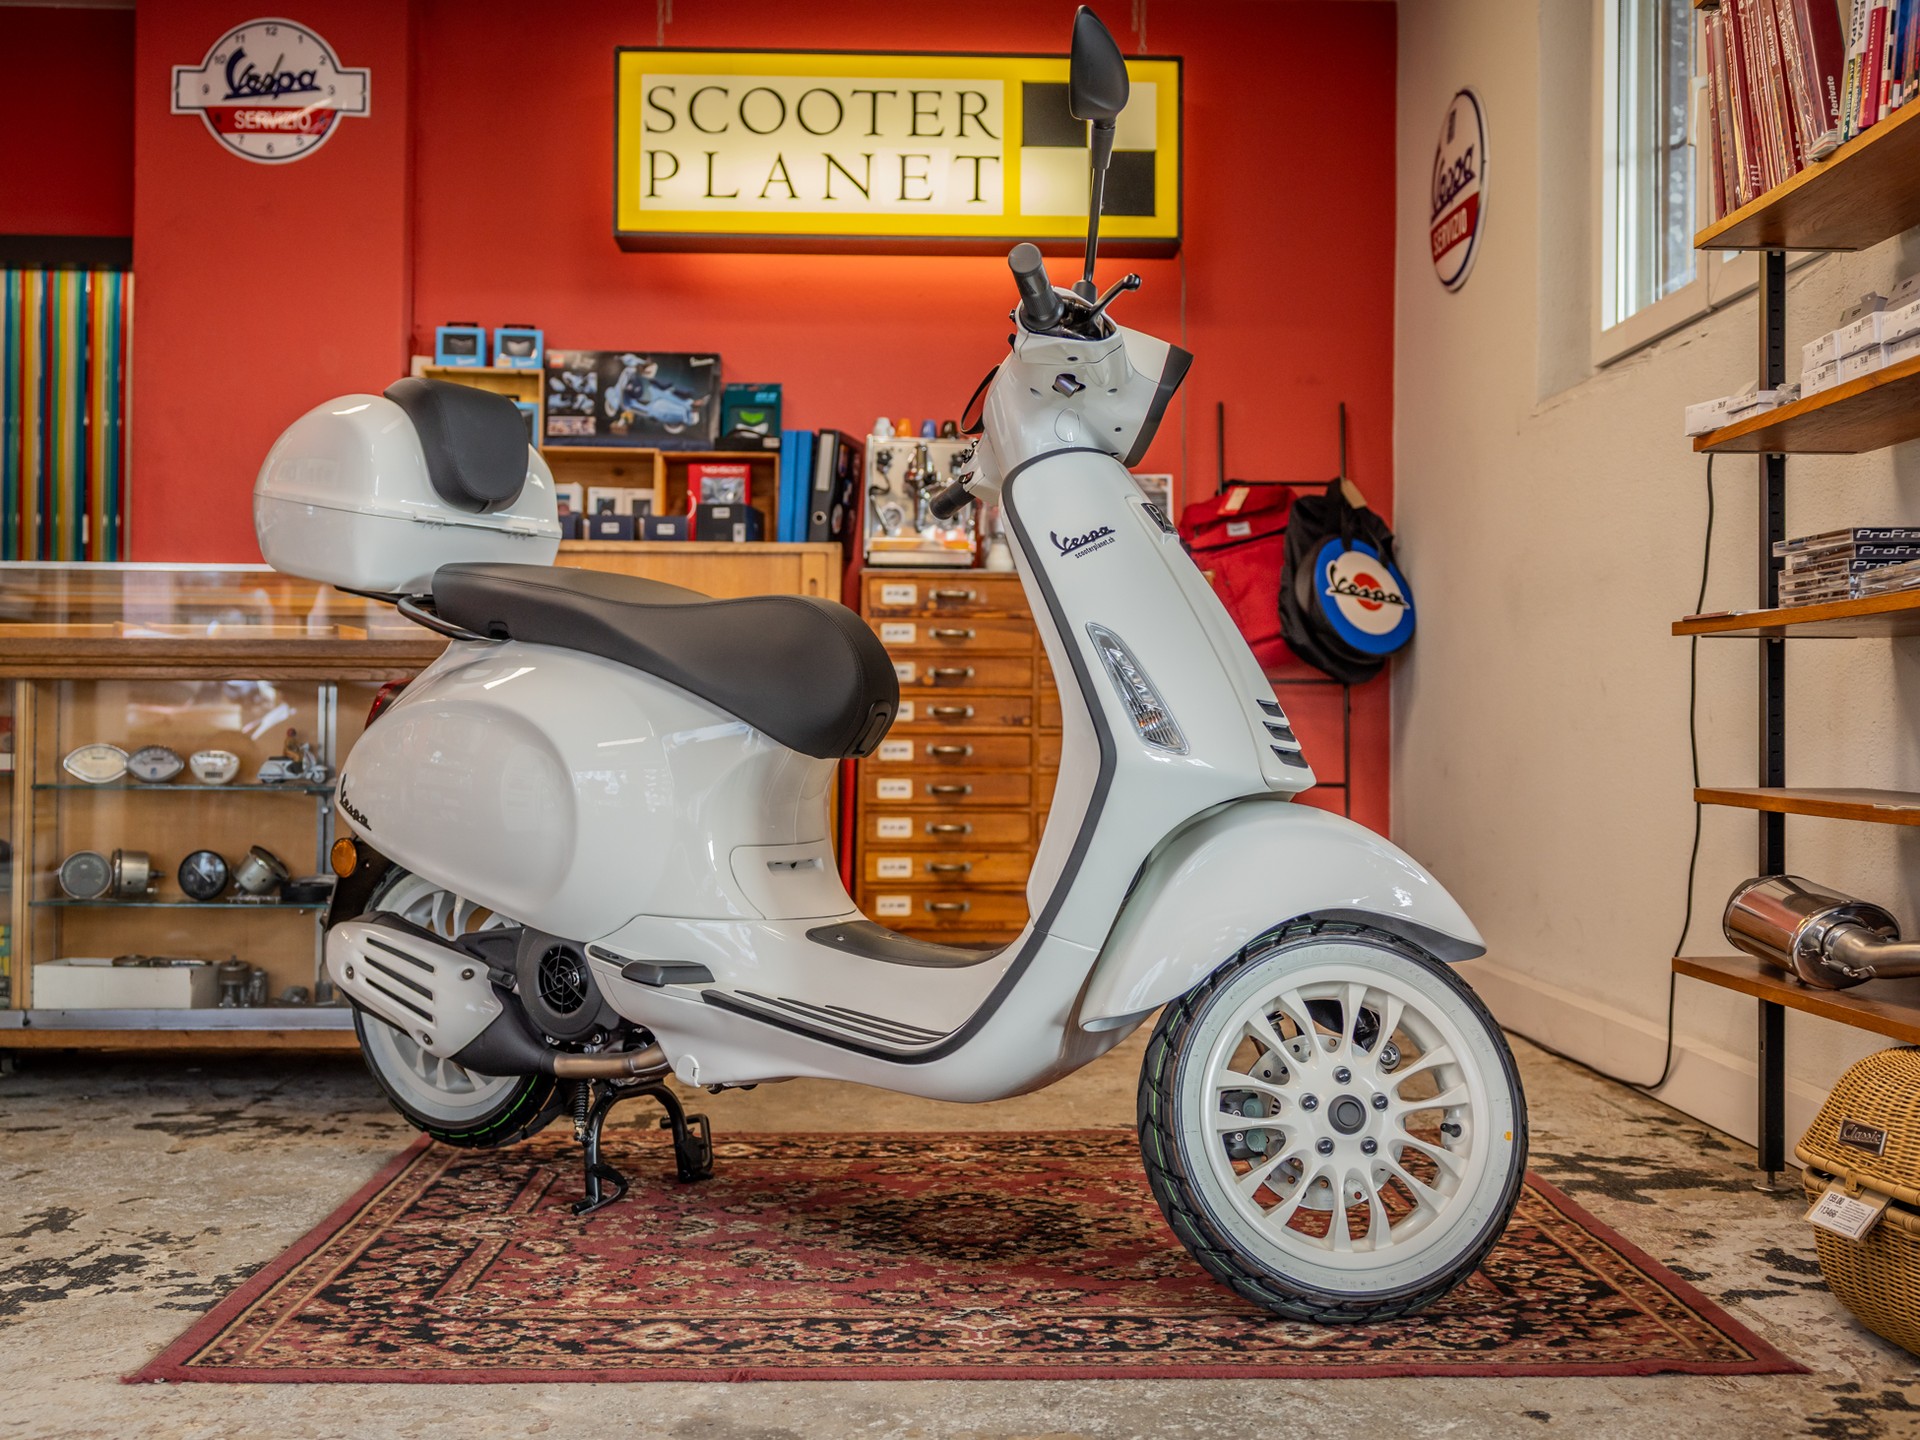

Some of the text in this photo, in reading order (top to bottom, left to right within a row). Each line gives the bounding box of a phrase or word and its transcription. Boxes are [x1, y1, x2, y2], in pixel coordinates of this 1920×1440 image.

[265, 26, 277, 36] 12
[221, 47, 322, 101] Vespa
[644, 85, 1000, 140] SCOOTER
[1827, 75, 1838, 116] Derivate
[645, 150, 1000, 203] PLANET
[1050, 527, 1116, 557] Vespa
[1075, 536, 1116, 559] scooterplanet.ch
[1330, 564, 1408, 607] Vespa
[339, 773, 372, 831] Vespa
[1843, 1124, 1882, 1145] Classic
